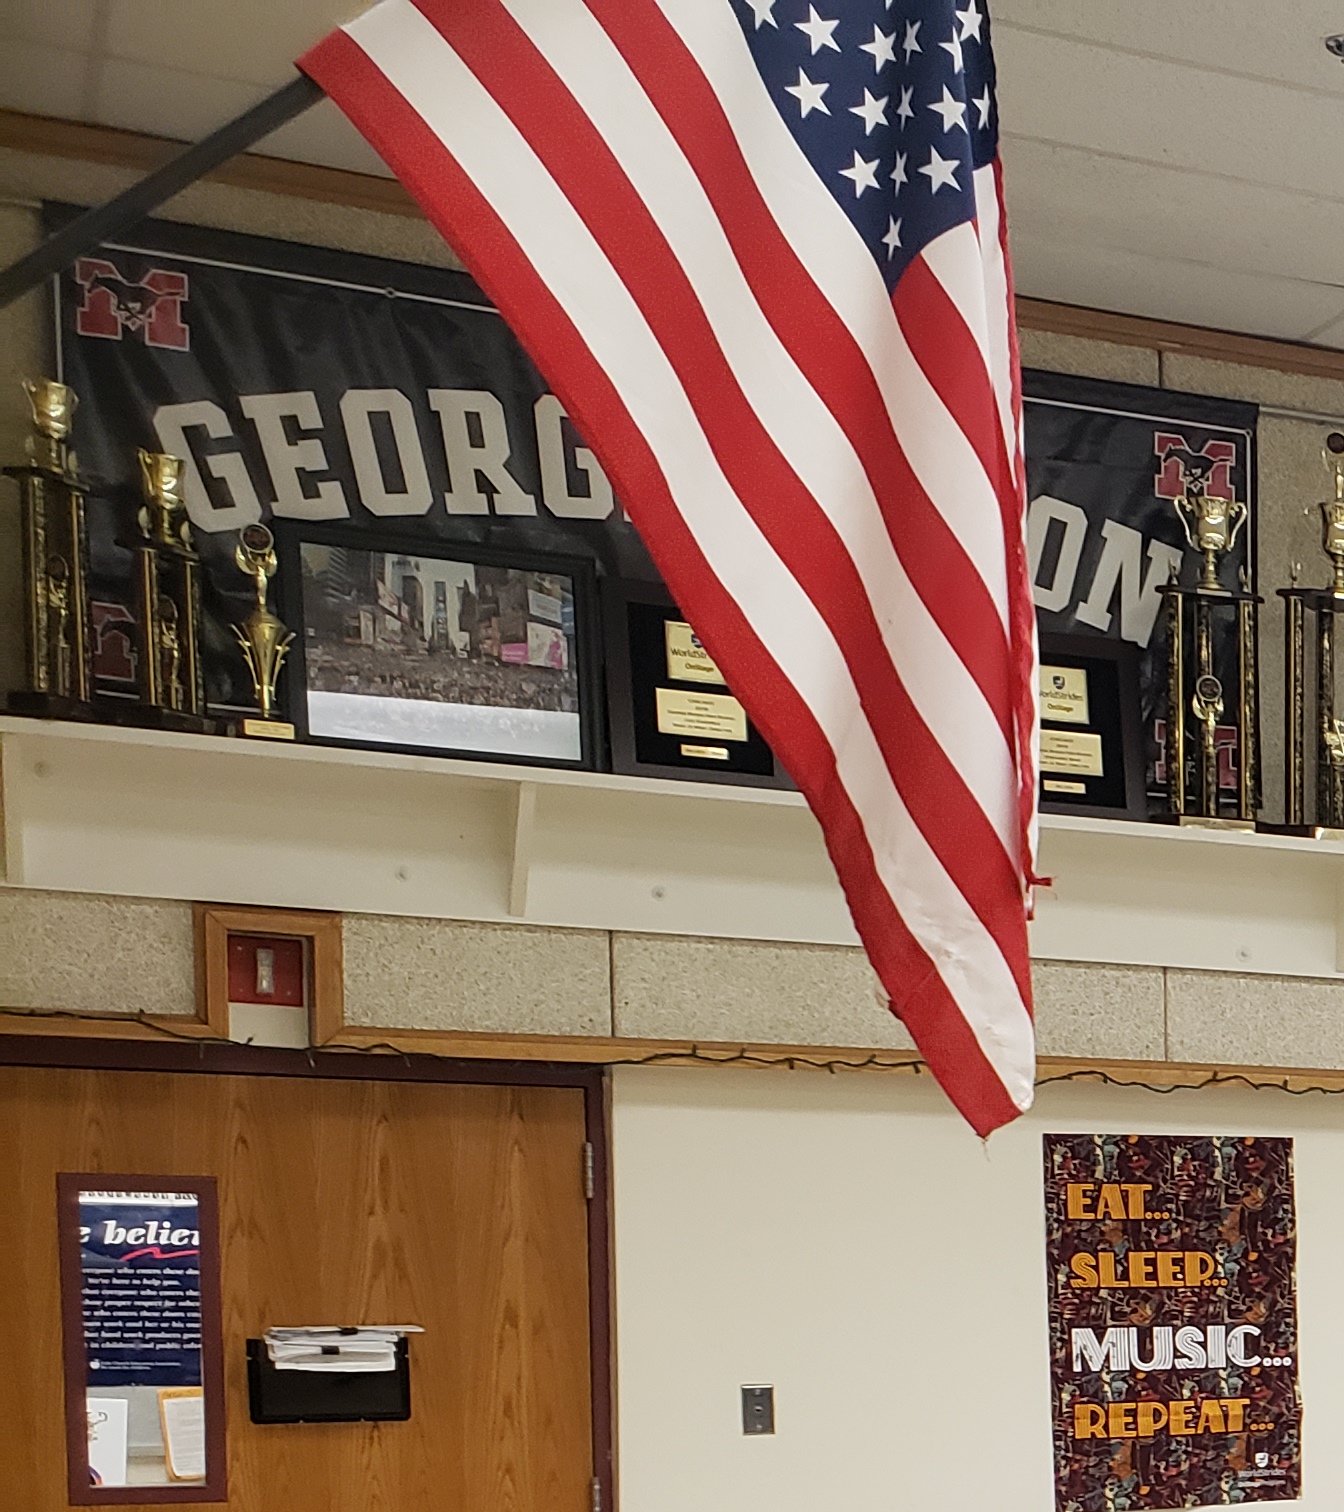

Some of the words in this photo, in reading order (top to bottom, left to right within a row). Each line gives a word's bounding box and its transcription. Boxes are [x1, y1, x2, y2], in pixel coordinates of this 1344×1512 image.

[1066, 1183, 1171, 1220] EAT...
[1069, 1251, 1229, 1289] SLEEP...
[1070, 1324, 1293, 1373] MUSIC...
